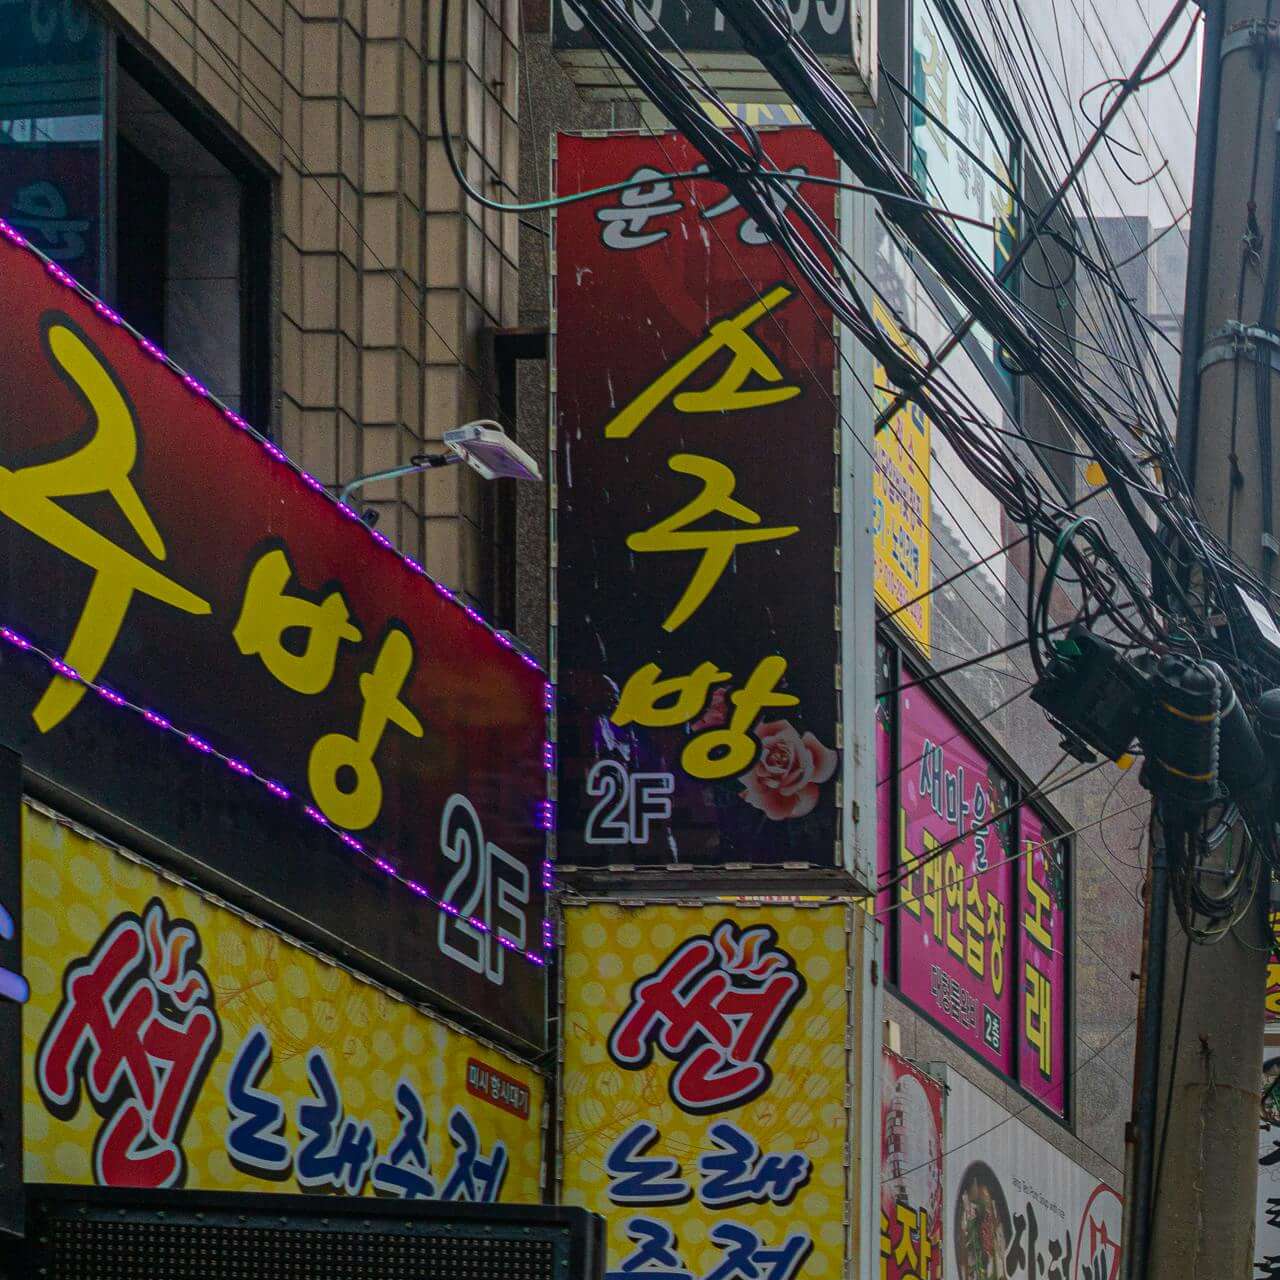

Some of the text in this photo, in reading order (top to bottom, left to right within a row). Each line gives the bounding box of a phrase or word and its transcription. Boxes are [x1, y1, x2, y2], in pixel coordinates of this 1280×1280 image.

[588, 762, 674, 845] 2F
[439, 793, 530, 986] 2F
[606, 1120, 810, 1206] 노래
